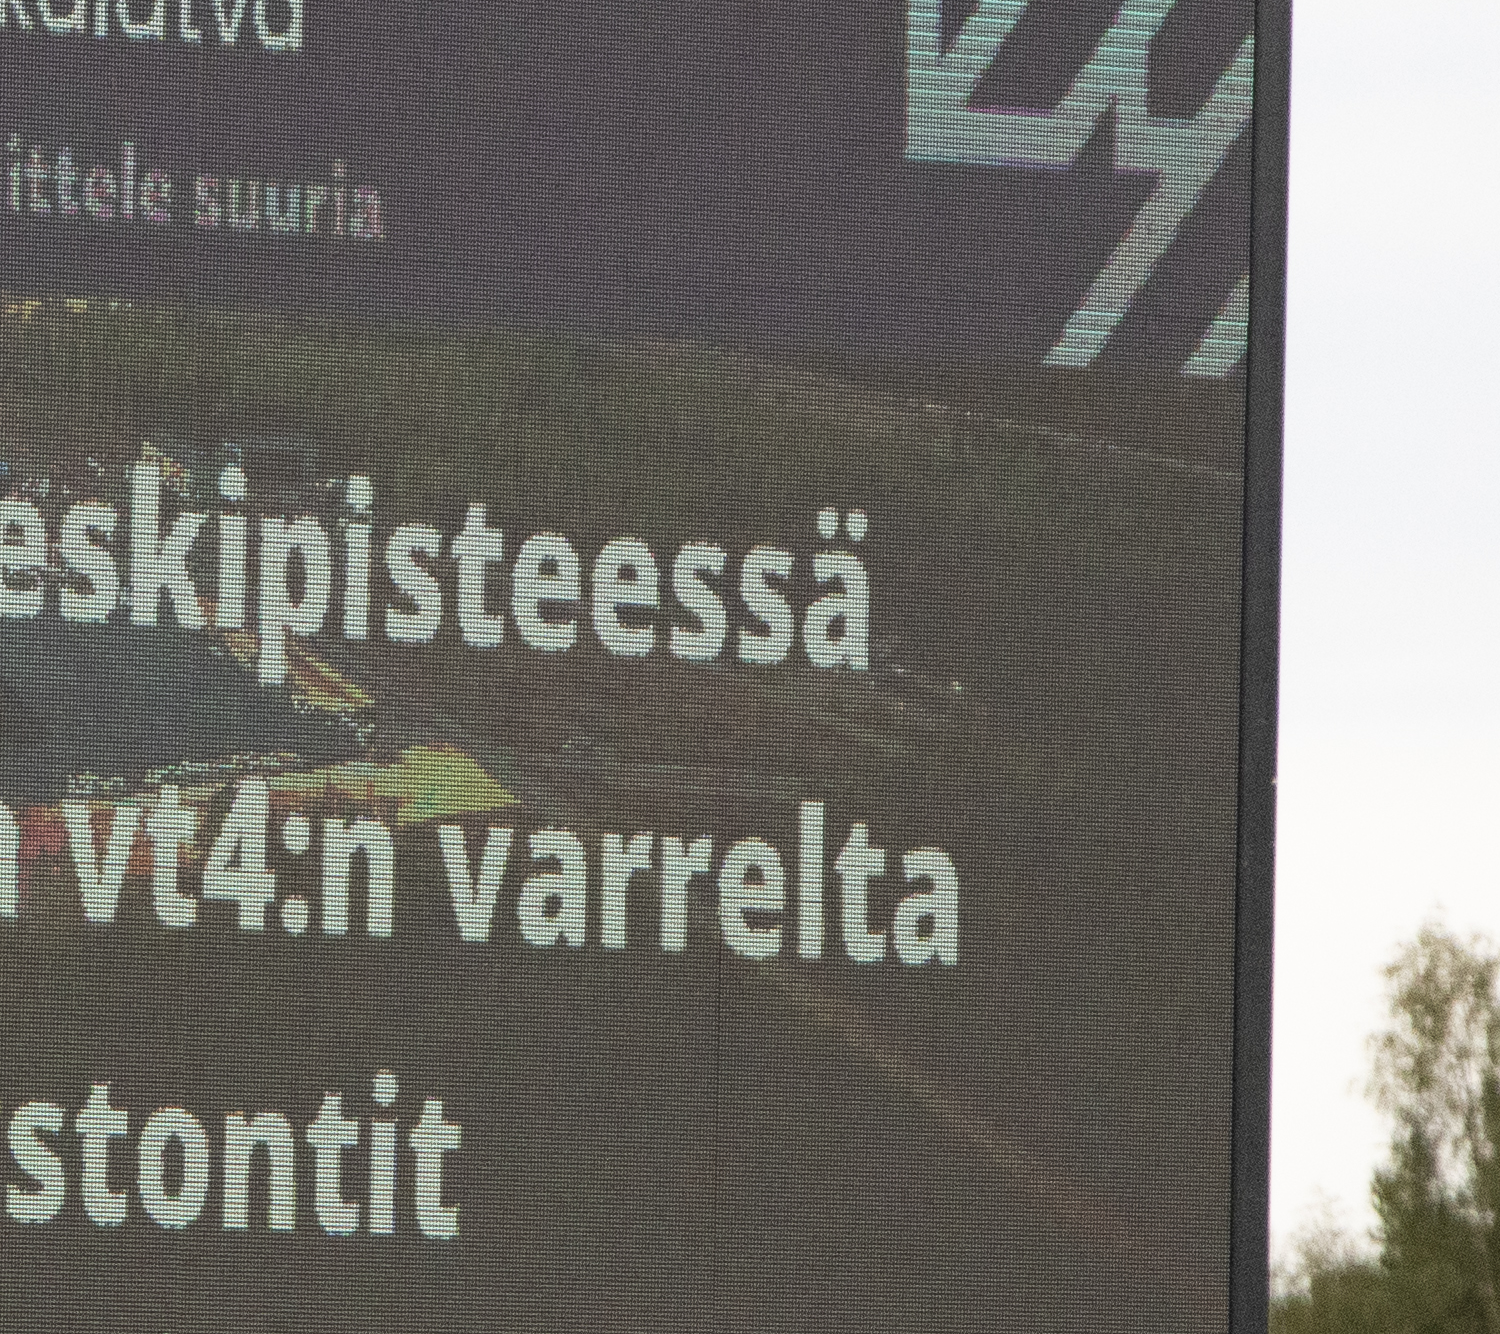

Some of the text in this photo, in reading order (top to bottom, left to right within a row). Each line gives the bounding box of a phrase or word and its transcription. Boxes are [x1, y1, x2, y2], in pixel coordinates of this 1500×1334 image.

[194, 159, 386, 239] suuria
[68, 779, 395, 939] vt4:n
[440, 799, 961, 967] varrelta
